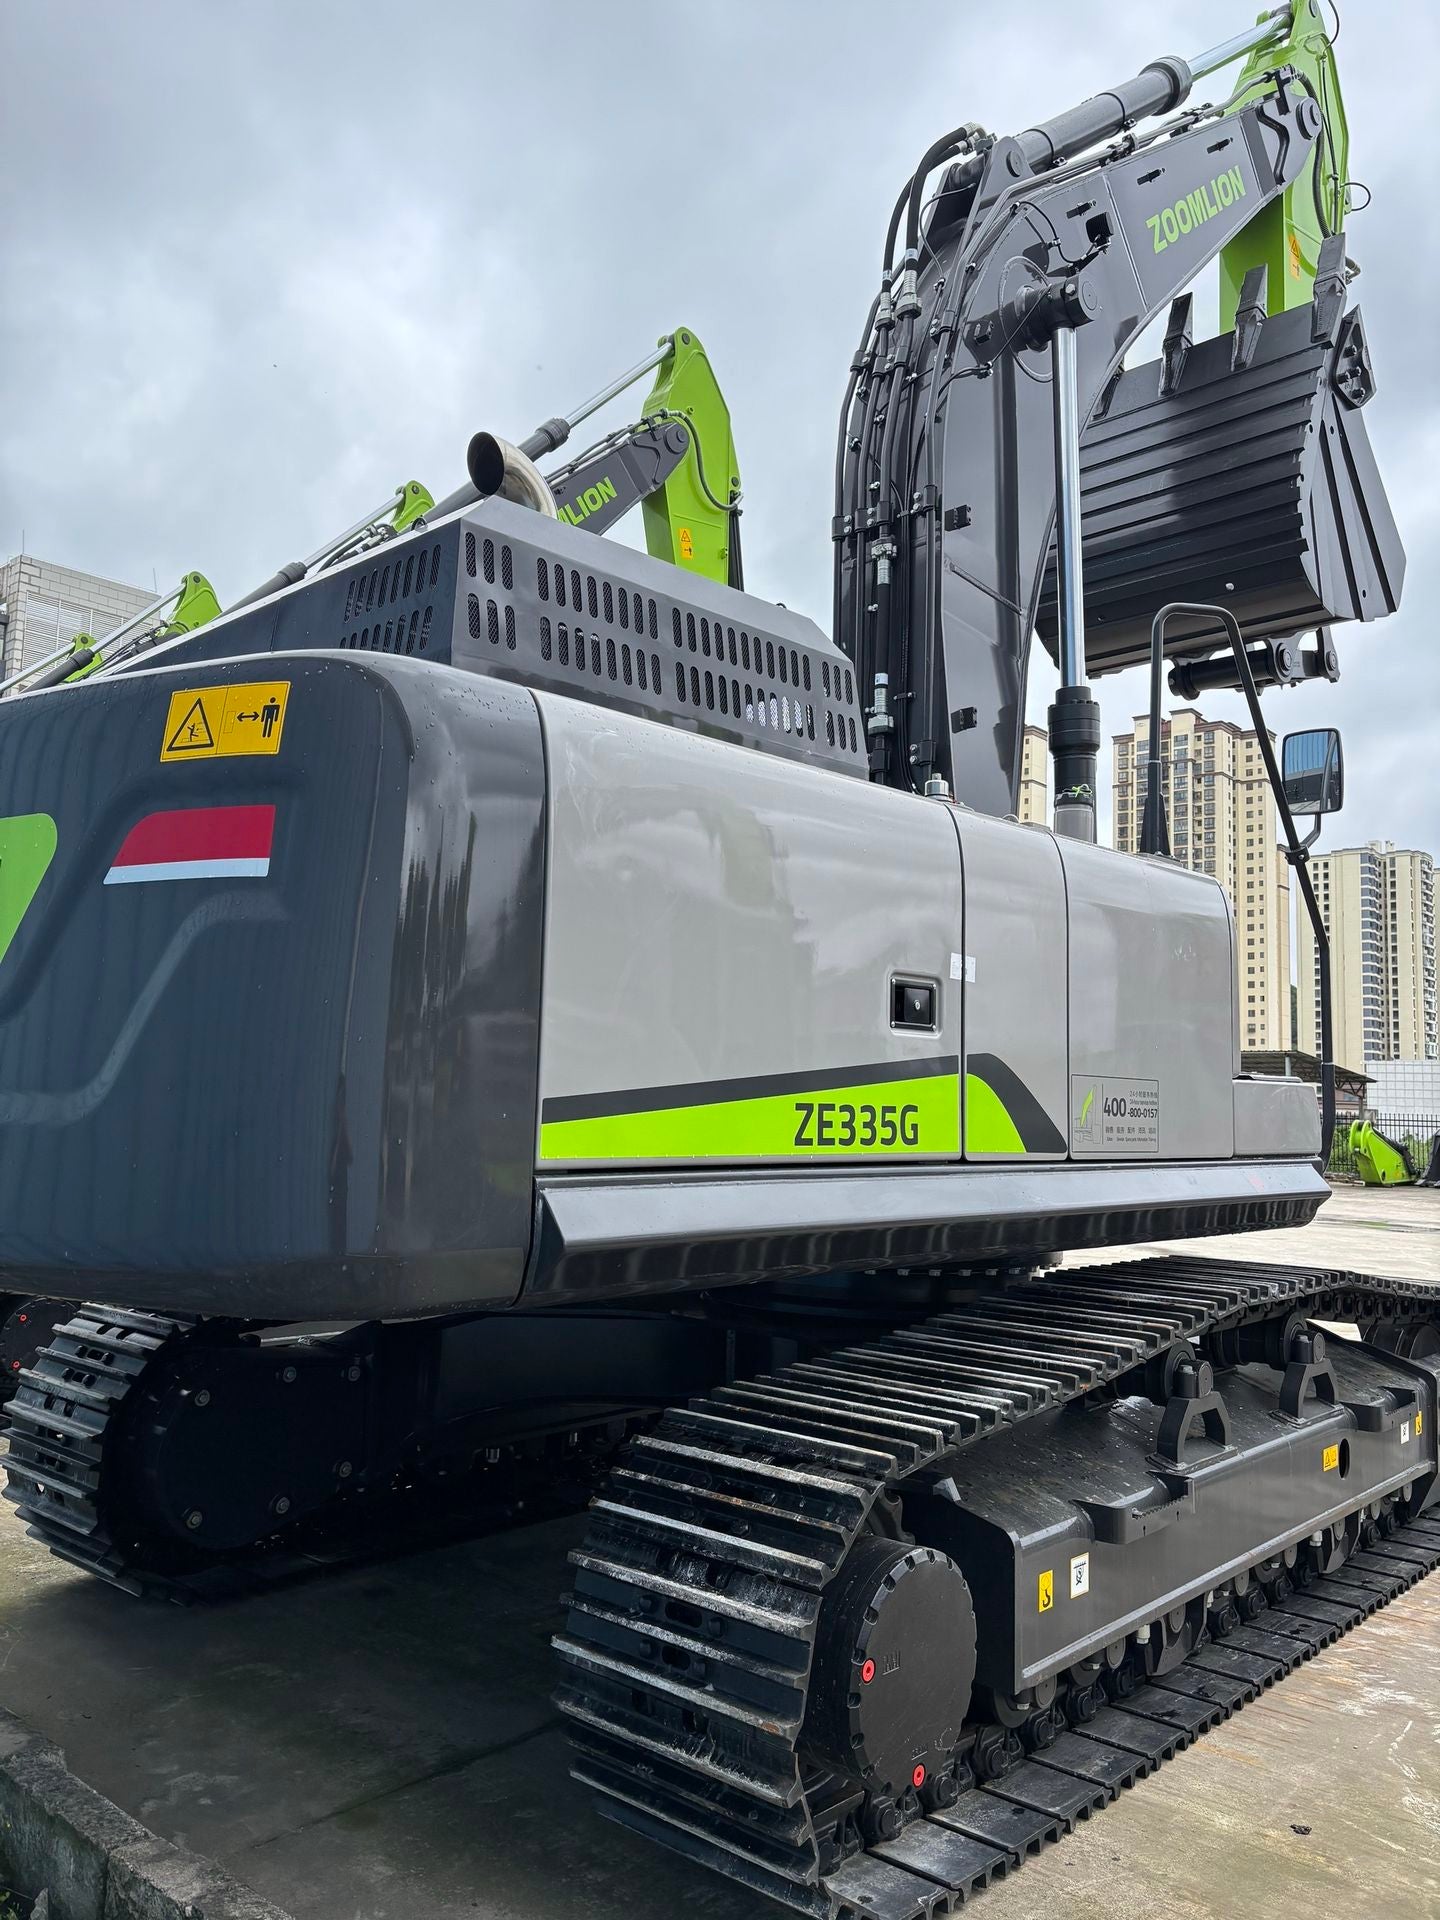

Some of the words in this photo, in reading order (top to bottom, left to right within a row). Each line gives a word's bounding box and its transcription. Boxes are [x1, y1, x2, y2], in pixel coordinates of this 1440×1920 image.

[1145, 165, 1246, 254] ZOOMLION
[794, 1103, 919, 1146] ZE335G
[1103, 1097, 1127, 1117] 400
[1127, 1107, 1158, 1118] -800-0157
